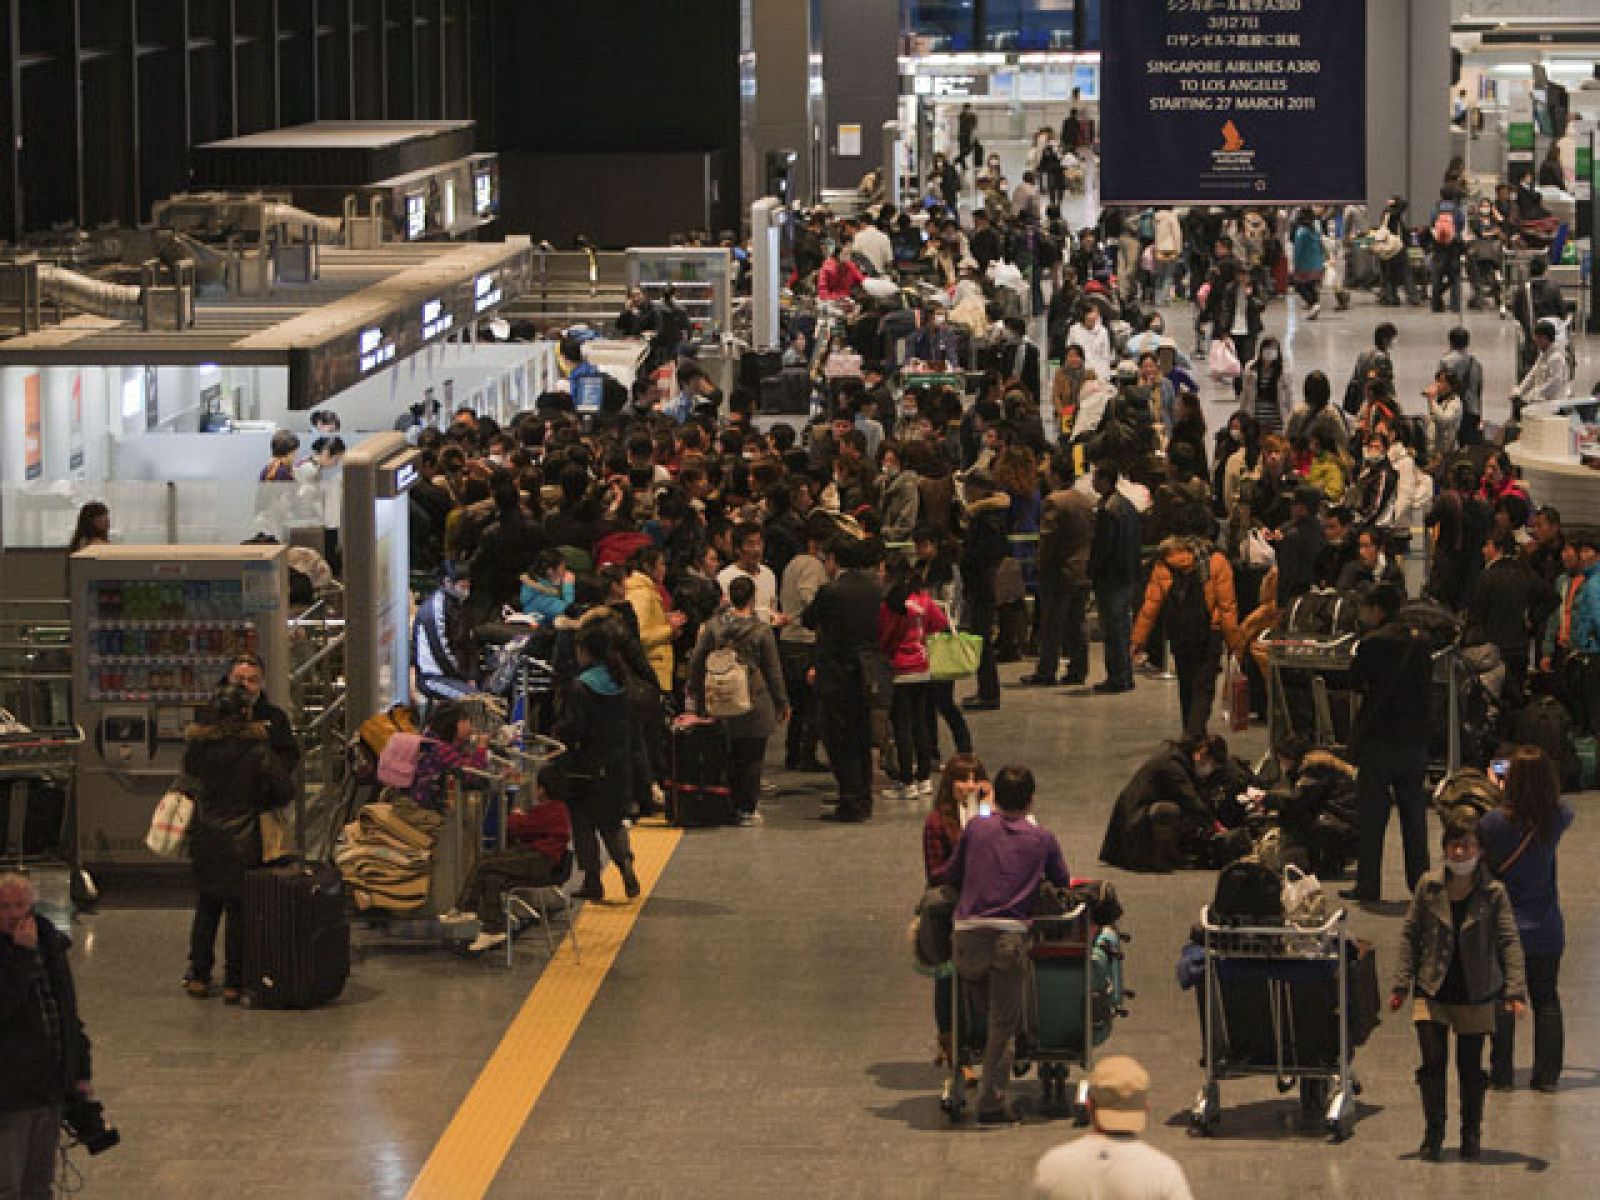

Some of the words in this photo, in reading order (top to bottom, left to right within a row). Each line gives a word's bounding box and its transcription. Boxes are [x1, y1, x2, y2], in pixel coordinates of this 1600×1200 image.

[1146, 60, 1222, 73] SINGAPORE
[1224, 60, 1284, 73] AIRLINES
[1287, 60, 1321, 73] A380
[1180, 79, 1199, 91] TO
[1202, 79, 1226, 91] LOS
[1229, 79, 1288, 91] ANGELES
[1149, 97, 1213, 111] STARTING
[1216, 97, 1233, 111] 27
[1235, 97, 1284, 111] MARCH
[1287, 97, 1316, 111] 2011
